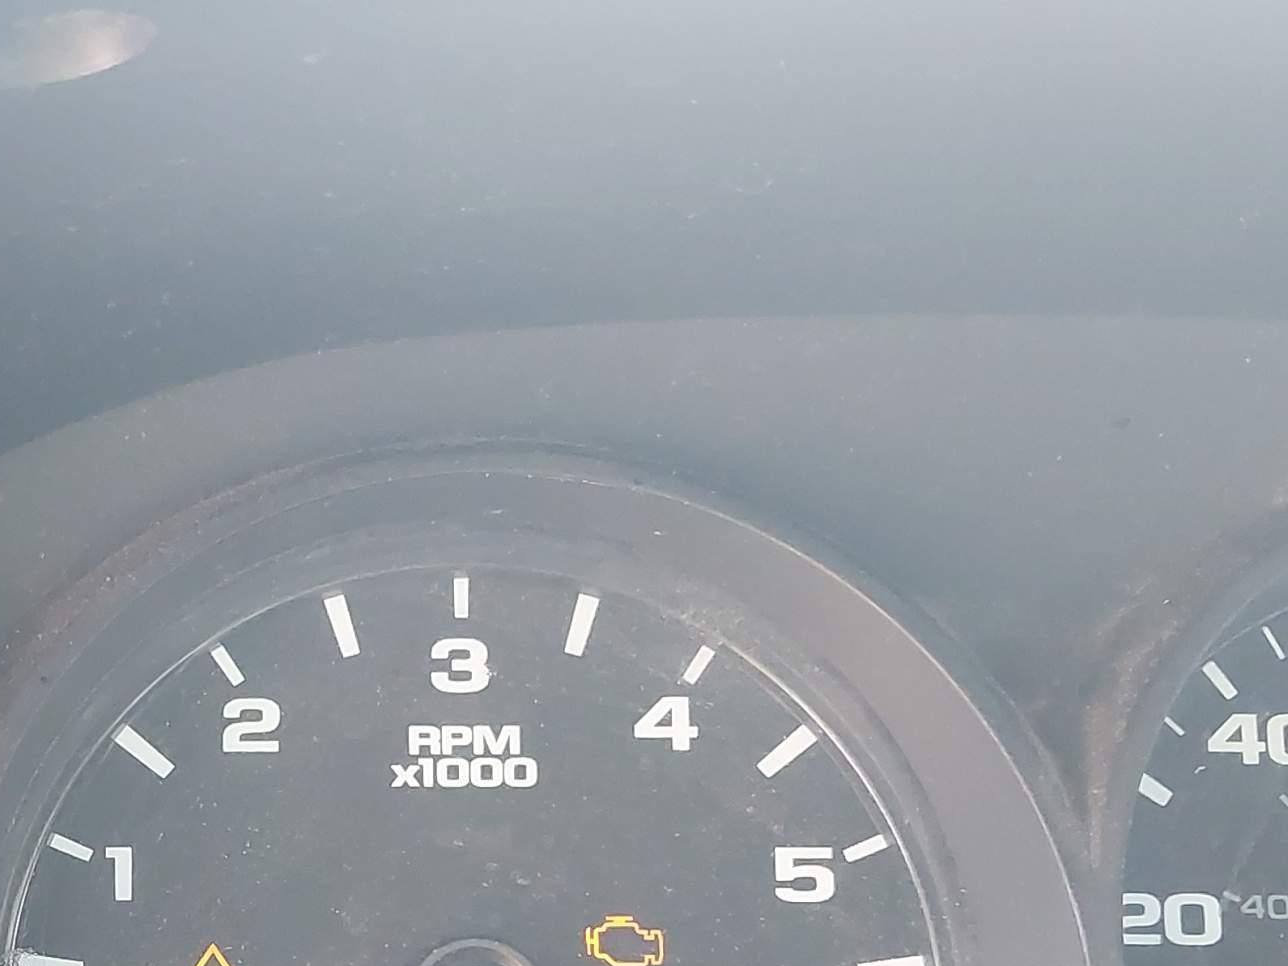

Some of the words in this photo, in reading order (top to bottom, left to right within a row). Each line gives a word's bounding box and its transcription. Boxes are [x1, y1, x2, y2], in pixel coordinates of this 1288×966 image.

[430, 637, 491, 694] 3
[221, 697, 282, 753] 2
[408, 725, 522, 756] RPM
[633, 696, 700, 751] 4
[390, 757, 539, 788] x1000
[105, 846, 133, 901] 1
[774, 846, 835, 903] 5
[1122, 892, 1223, 946] 20
